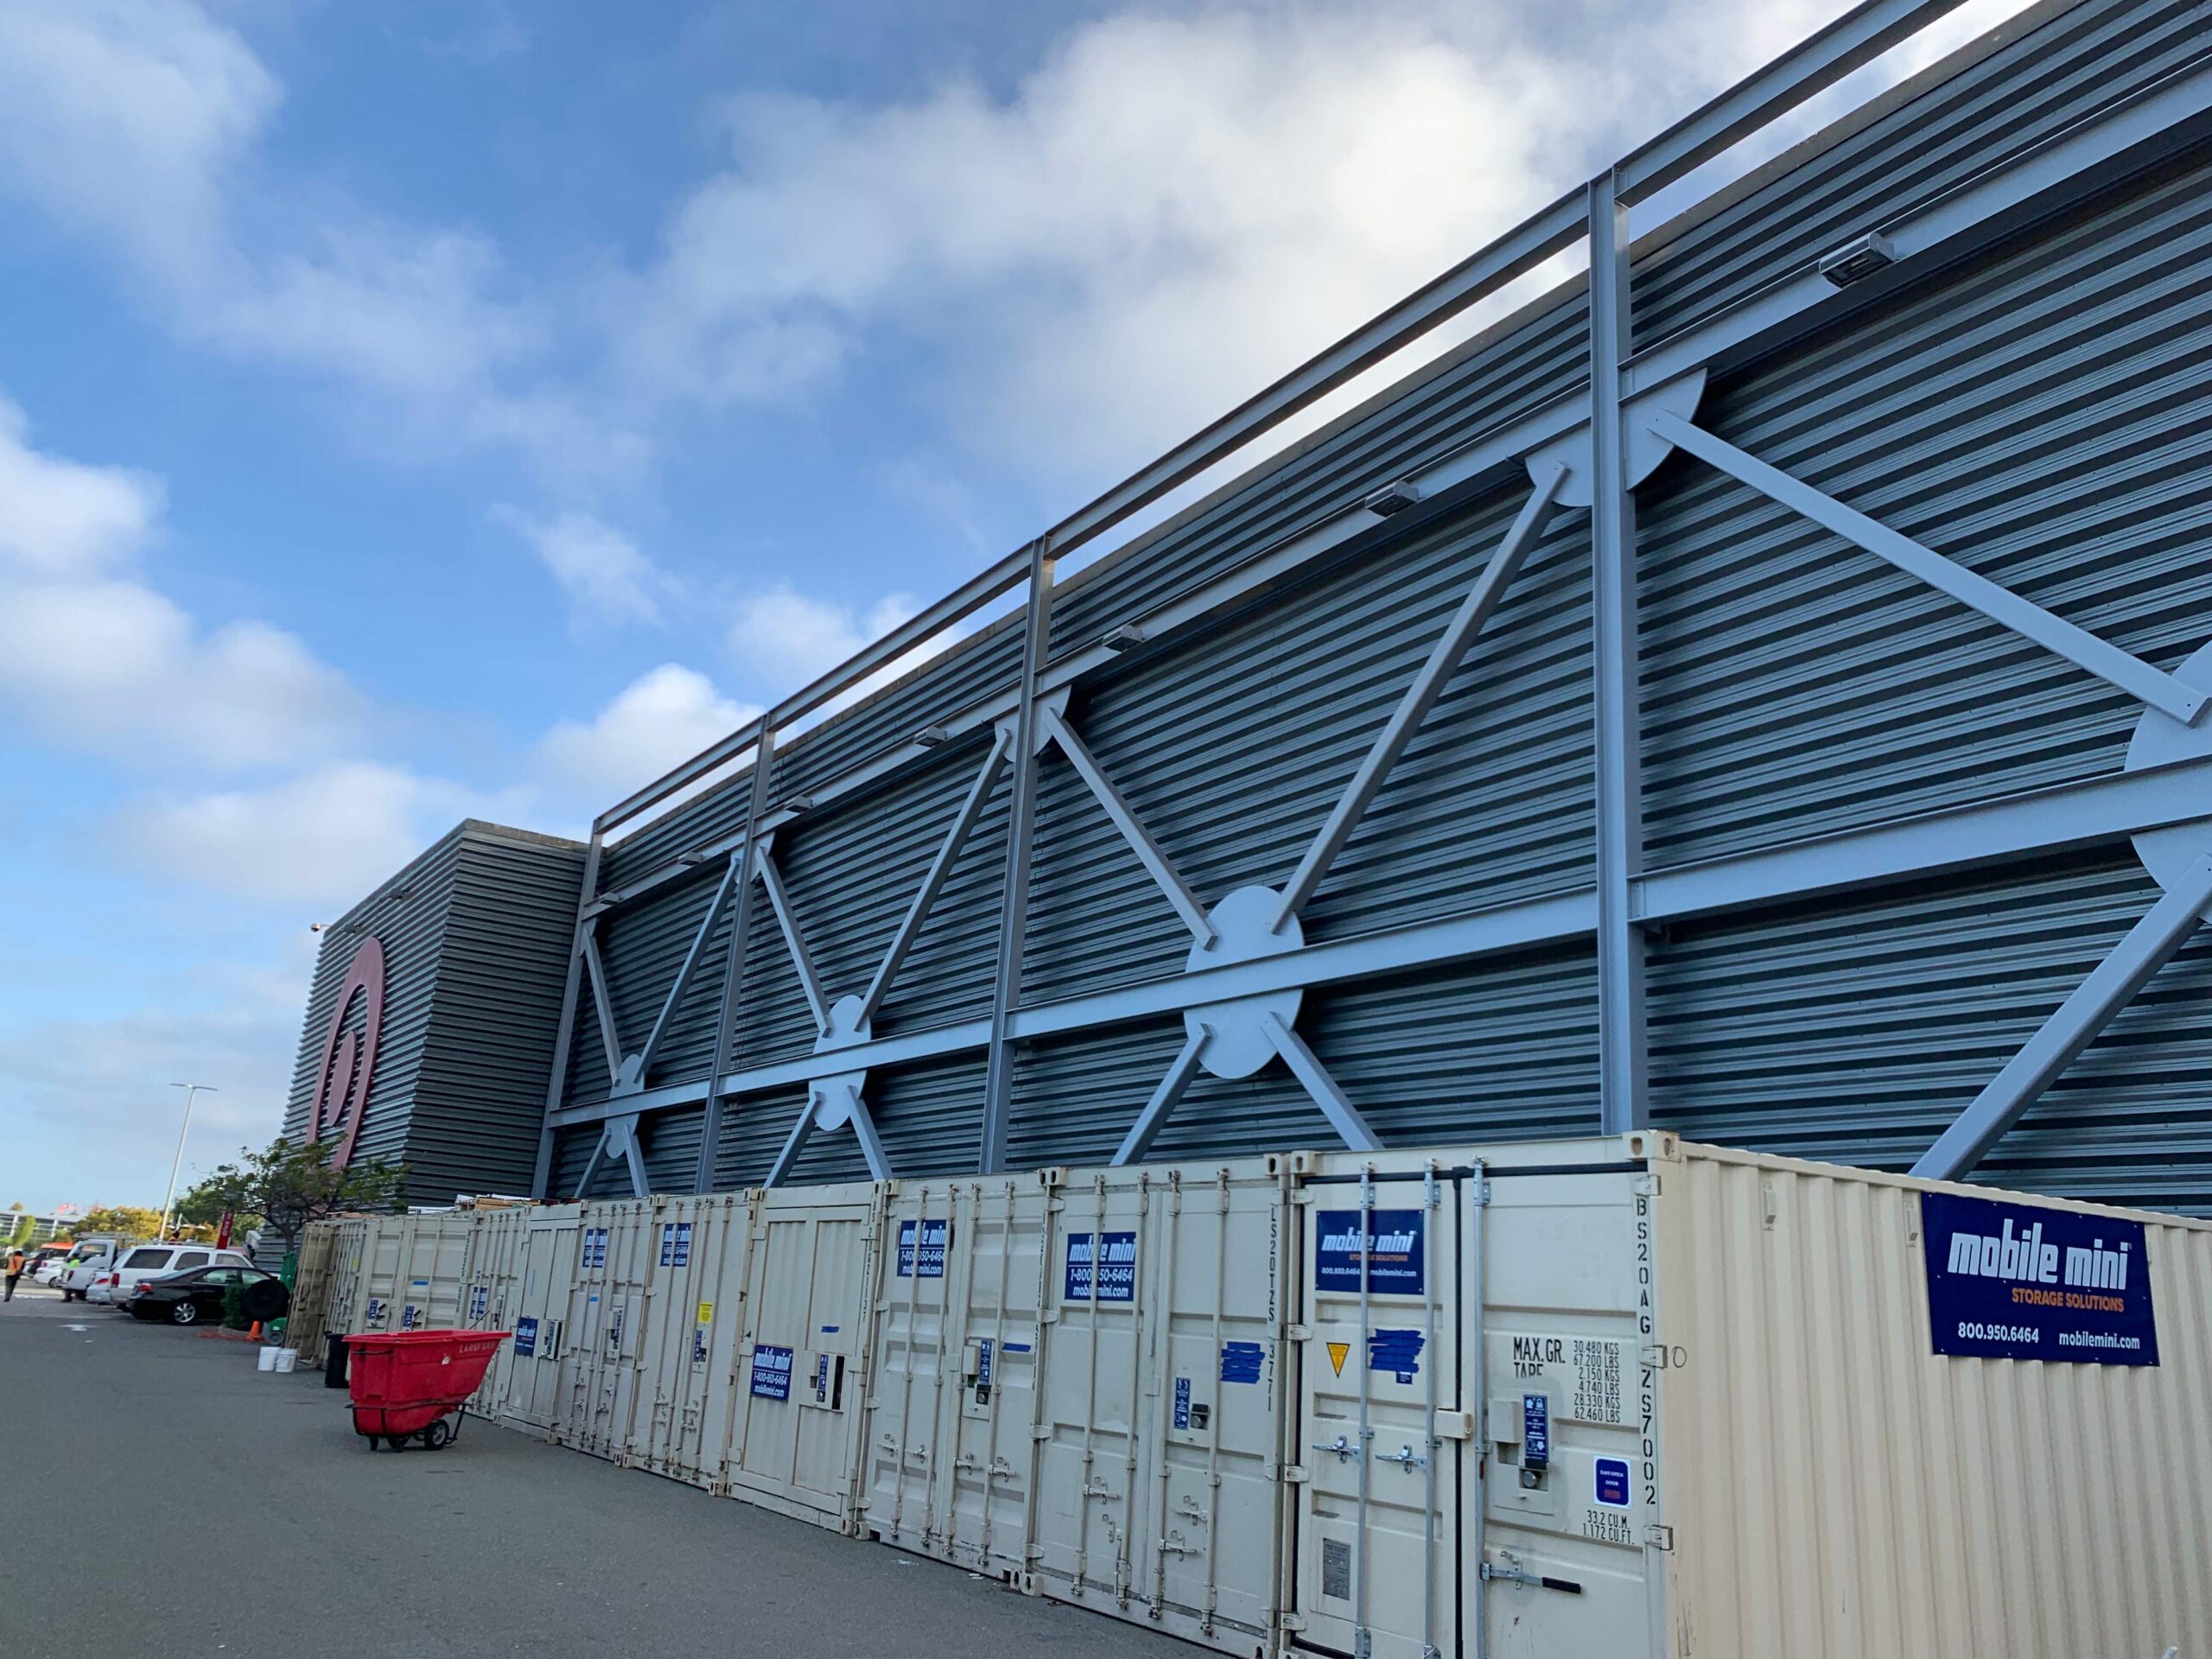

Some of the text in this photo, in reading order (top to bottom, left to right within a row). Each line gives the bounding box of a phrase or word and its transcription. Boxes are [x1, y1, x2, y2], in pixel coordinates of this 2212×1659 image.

[1376, 1230, 1415, 1252] mini
[1948, 1218, 2128, 1290] mobile mini
[2012, 1287, 2125, 1313] STORAGE SOLUTIONS
[1958, 1322, 2140, 1350] 800.950.6464 mobilemini.com
[1604, 1342, 1619, 1355] KGS
[1605, 1356, 1619, 1369] LBS
[1605, 1369, 1620, 1382] KGS
[1605, 1382, 1620, 1395] LBS
[1605, 1395, 1621, 1409] KGS
[1605, 1409, 1621, 1423] LBS
[1587, 1510, 1605, 1525] 33.2
